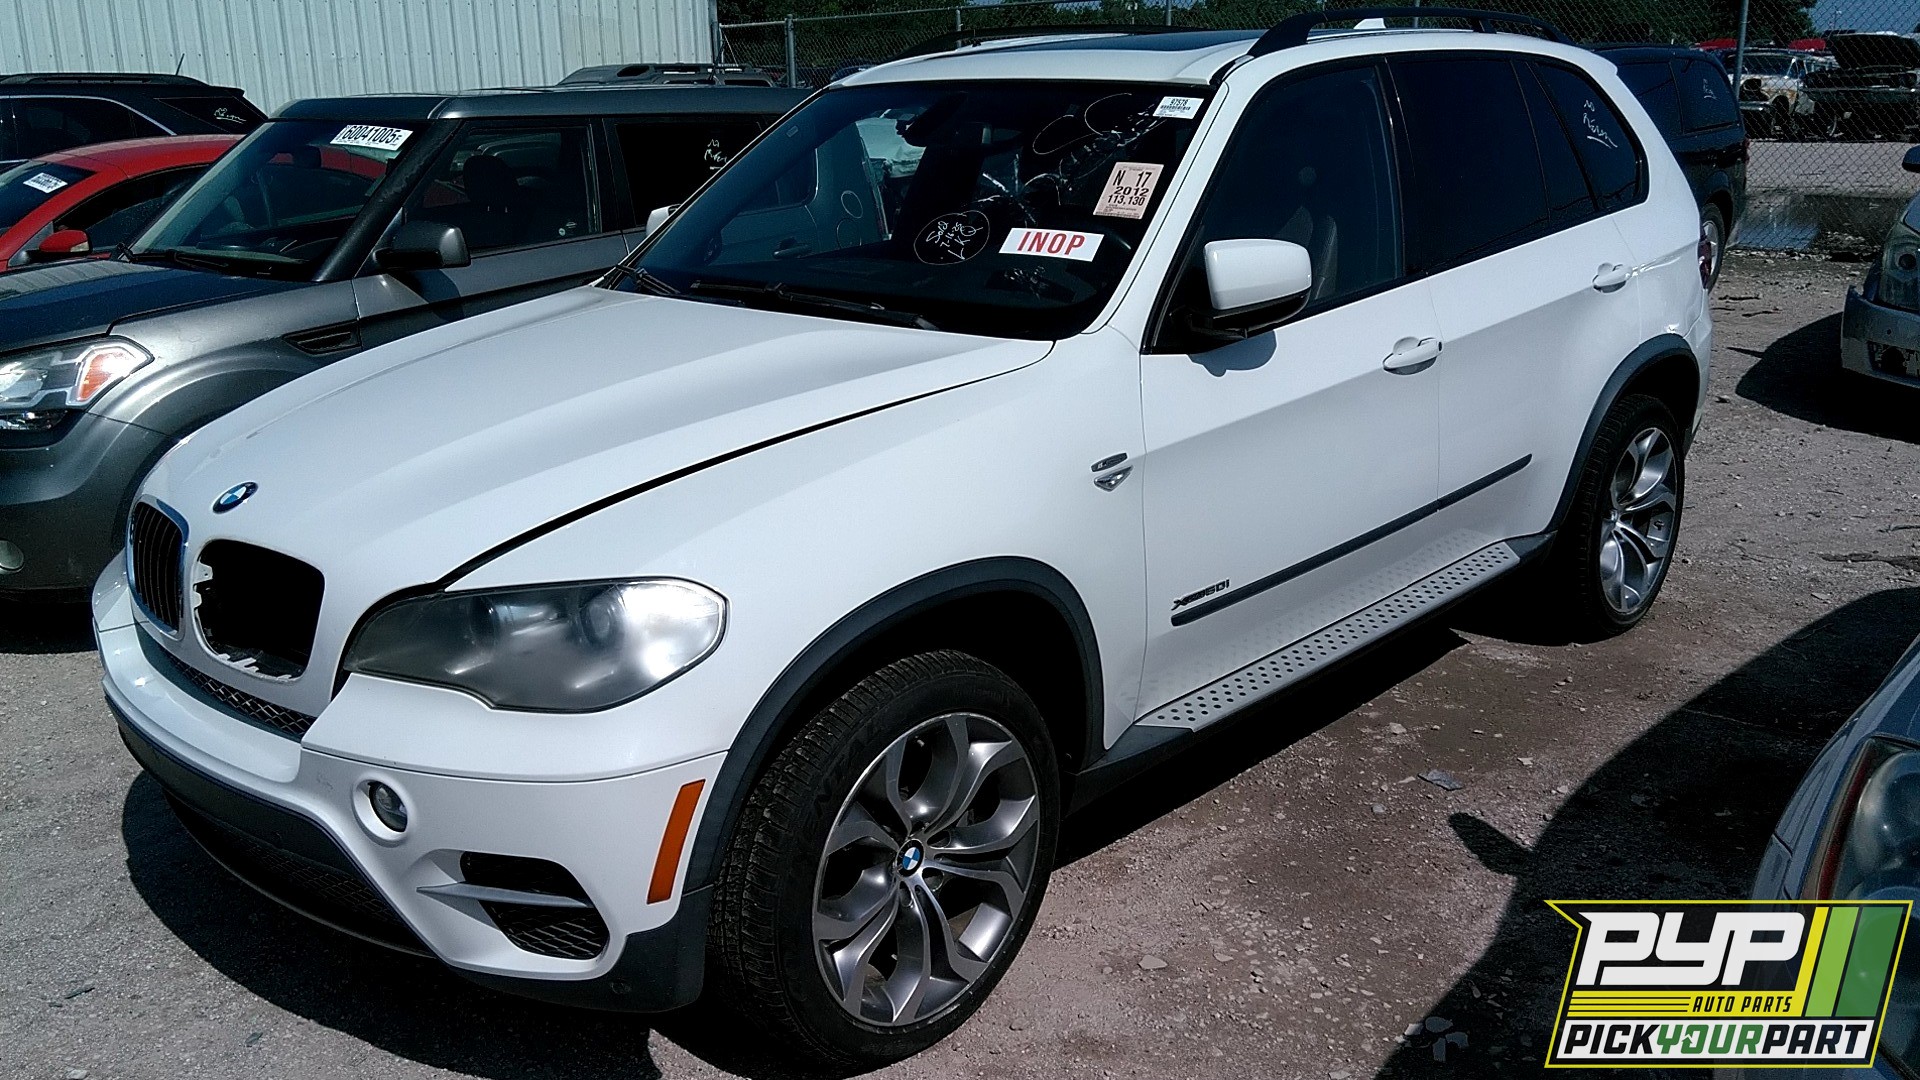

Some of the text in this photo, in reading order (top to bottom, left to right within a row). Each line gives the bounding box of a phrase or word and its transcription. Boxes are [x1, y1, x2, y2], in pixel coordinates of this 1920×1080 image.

[1112, 169, 1153, 188] N 17
[1113, 185, 1150, 198] 2012
[1017, 231, 1085, 256] INOP
